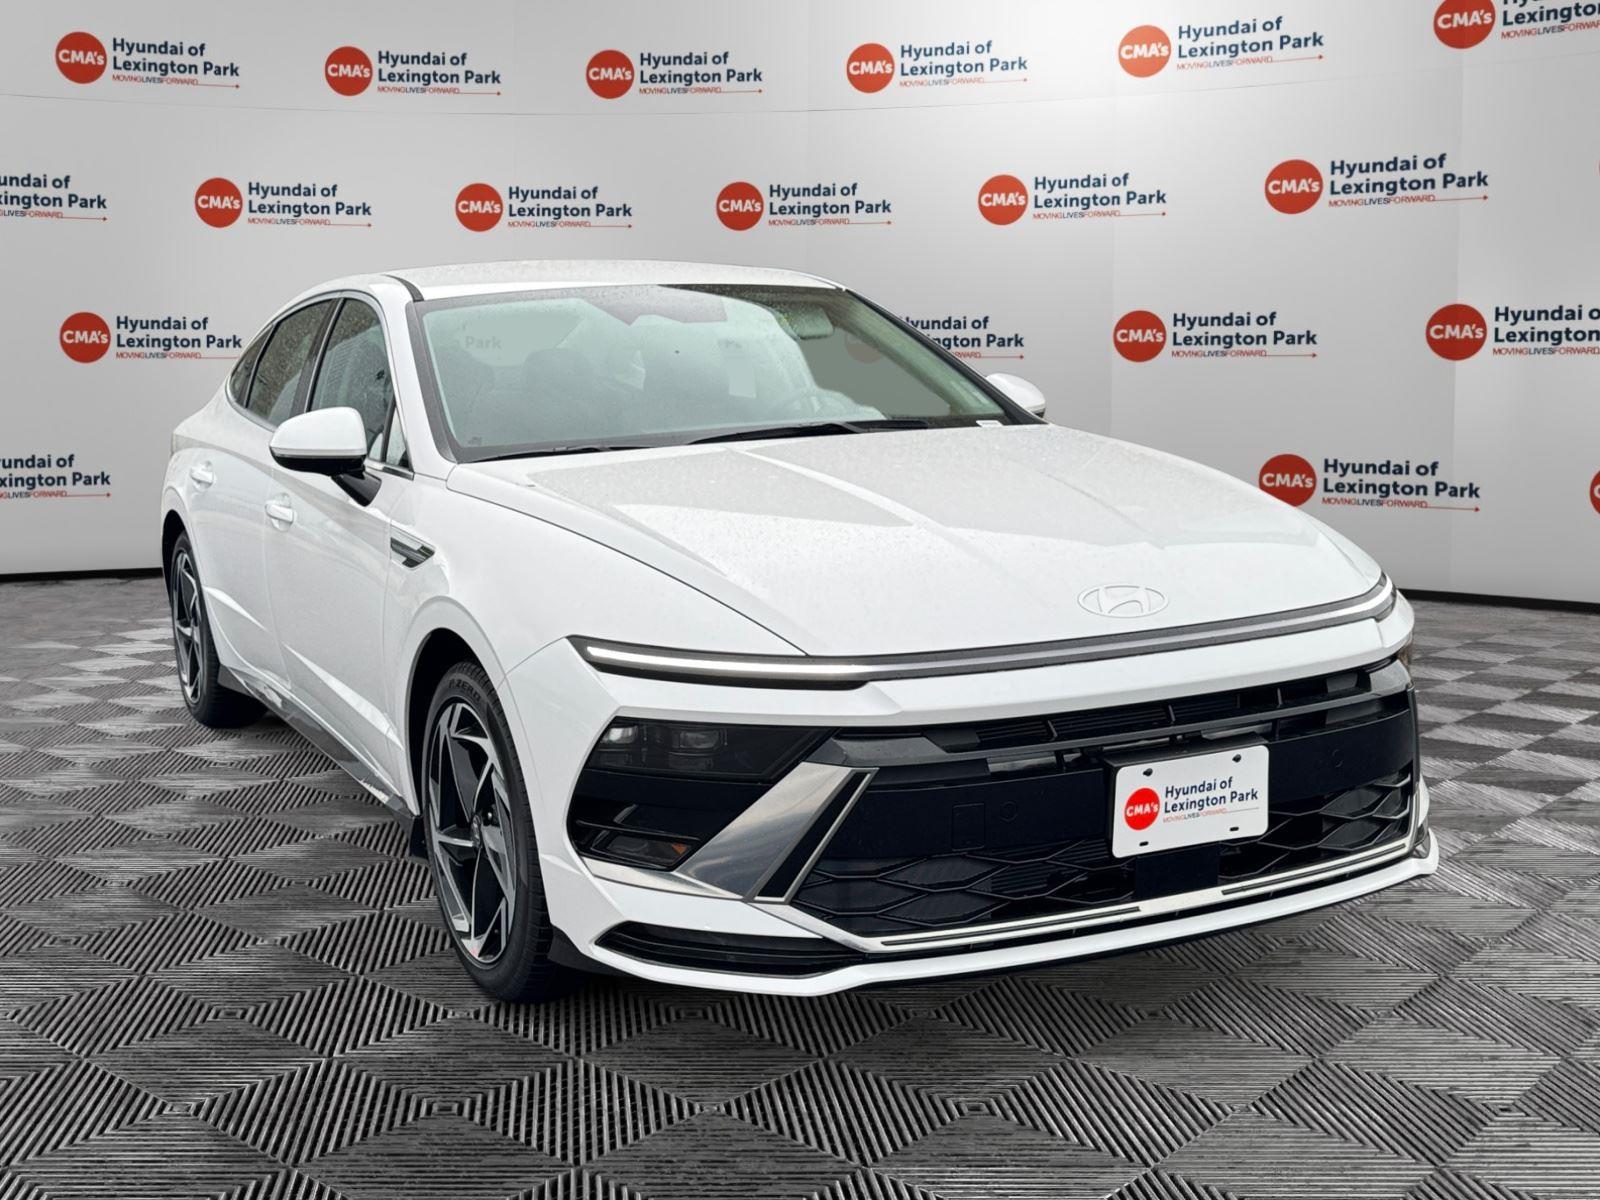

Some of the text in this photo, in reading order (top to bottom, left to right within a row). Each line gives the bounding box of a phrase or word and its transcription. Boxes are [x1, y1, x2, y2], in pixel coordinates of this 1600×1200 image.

[1436, 8, 1493, 30] CMA's
[1502, 1, 1600, 27] Lexingto
[1178, 16, 1283, 42] Hyundai of
[113, 37, 205, 56] Hyundai of
[901, 40, 992, 61] Hyundai of
[1120, 40, 1170, 59] CMA's
[1178, 32, 1323, 58] Lexington Park
[58, 47, 105, 66] CMA's
[378, 51, 467, 68] Hyundai of
[640, 51, 729, 70] Hyundai of
[113, 56, 239, 76] Lexington Park
[328, 62, 372, 80] CMA's
[589, 66, 633, 80] CMA's
[850, 60, 893, 76] CMA's
[900, 57, 1027, 77] Lexington Park
[378, 68, 500, 86] Lexington Park
[640, 68, 762, 86] Lexington Park
[1331, 153, 1447, 178] Hyundai of
[0, 173, 70, 189] undai of
[1034, 173, 1129, 193] Hyundai of
[1267, 176, 1319, 194] CMA's
[1330, 171, 1488, 196] Lexington Park
[248, 182, 337, 199] Hyundai of
[509, 186, 598, 203] Hyundai of
[769, 182, 857, 201] Hyundai of
[980, 190, 1025, 206] CMA's
[0, 191, 107, 210] ington Park
[198, 194, 241, 208] CMA's
[248, 200, 371, 218] Lexington Park
[458, 200, 500, 213] CMA's
[719, 200, 760, 212] CMA's
[769, 199, 891, 218] Lexington Park
[1034, 190, 1166, 210] Lexington Park
[509, 203, 632, 220] Lexington Park
[971, 316, 989, 329] of
[1173, 311, 1276, 331] Hyundai of
[1495, 304, 1600, 326] Hyundai o
[116, 316, 208, 333] Hyundai of
[1430, 324, 1483, 338] CMA's
[63, 330, 108, 343] CMA's
[116, 333, 242, 351] Lexington Park
[465, 336, 502, 350] Park
[986, 333, 1024, 347] Park
[1115, 327, 1163, 342] CMA's
[1173, 330, 1317, 349] Lexington Park
[1494, 326, 1600, 346] Lexington
[0, 453, 75, 469] undai of
[1324, 458, 1439, 477] Hyundai of
[0, 471, 110, 490] xington Park
[1261, 473, 1312, 490] CMA's
[1323, 477, 1480, 498] Lexington Park
[1165, 776, 1233, 800] Hyundai of
[1164, 788, 1258, 813] Lexington Park
[1125, 802, 1158, 818] CMA's
